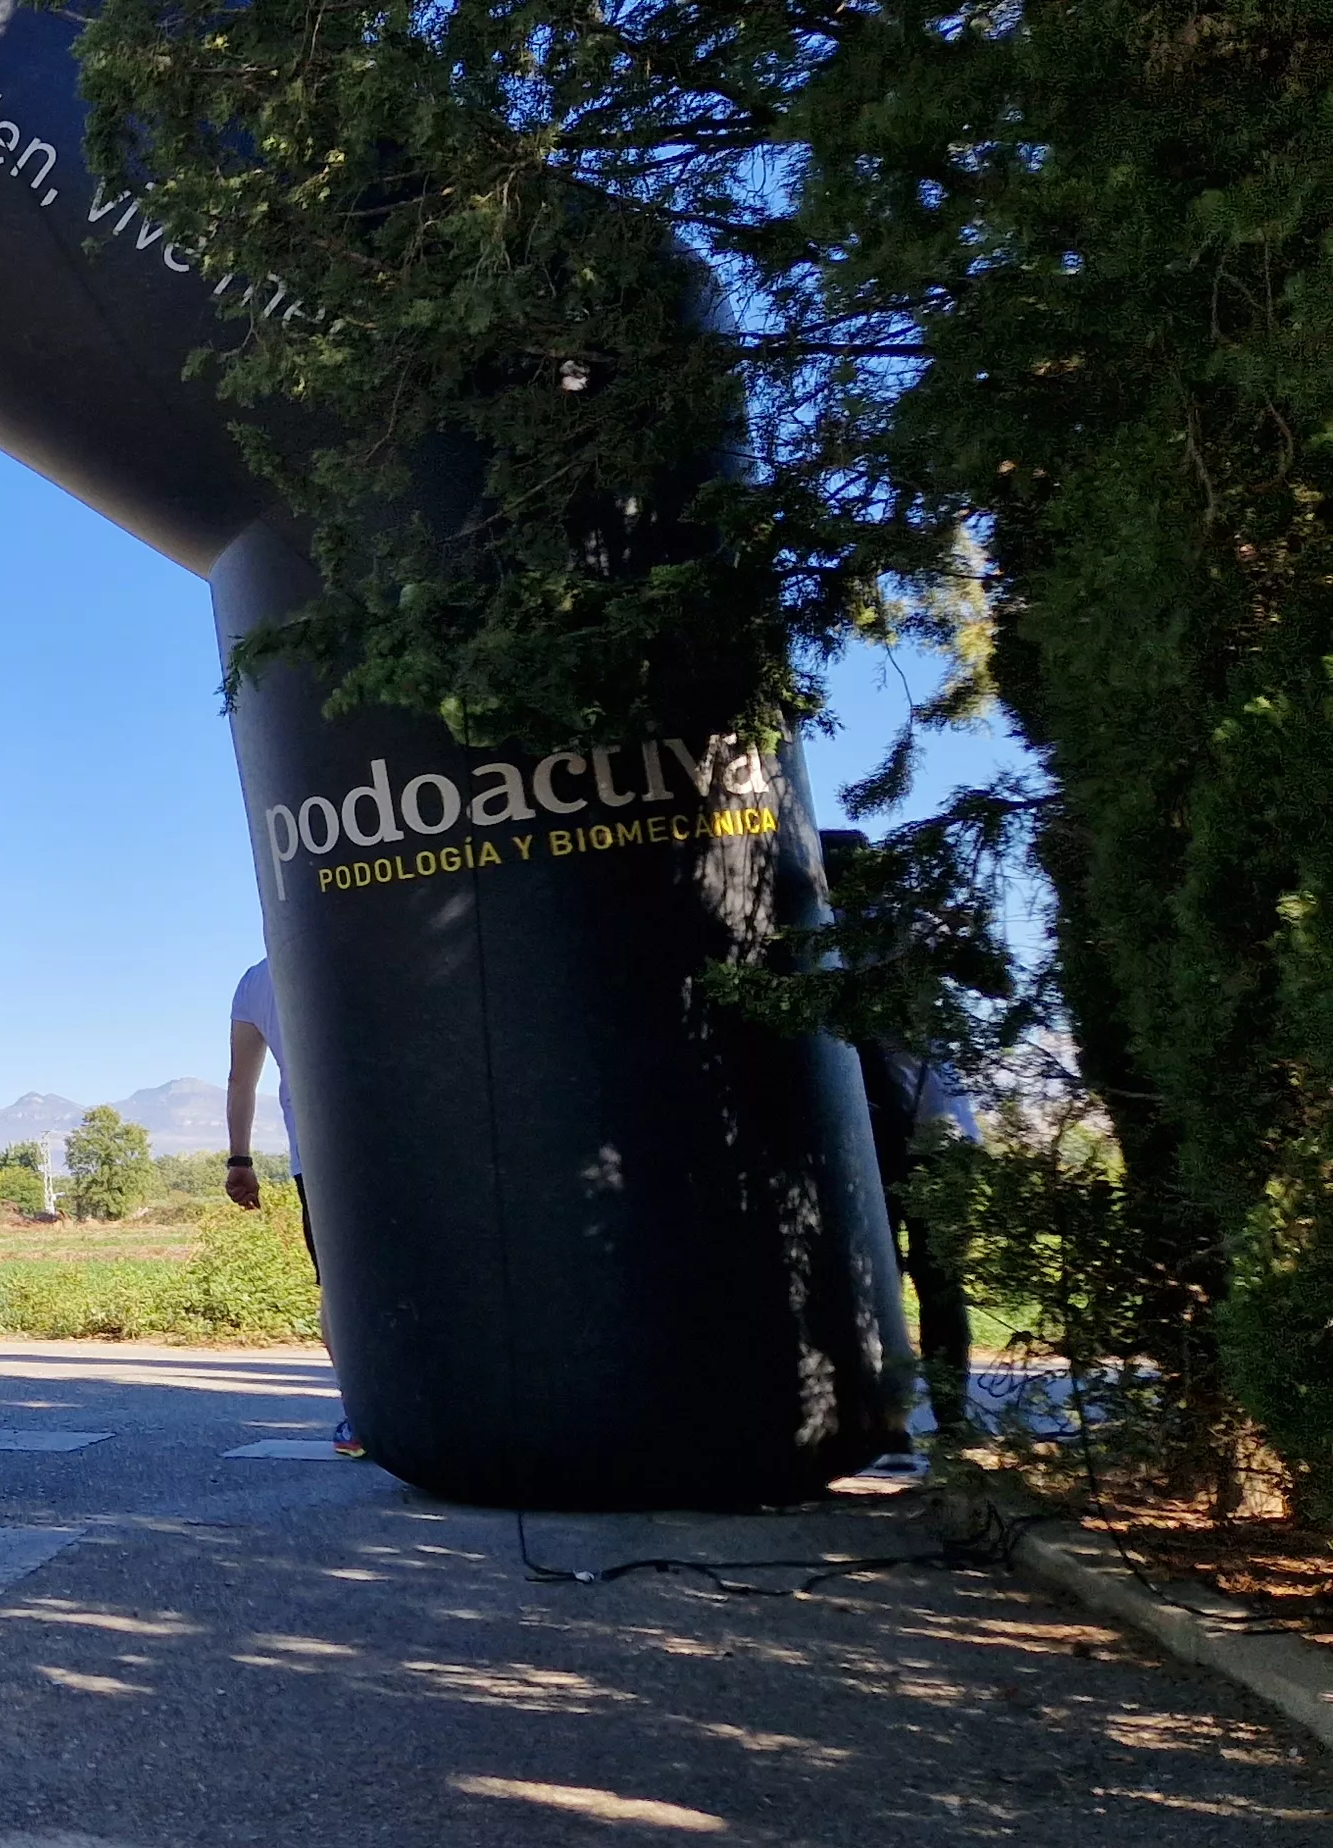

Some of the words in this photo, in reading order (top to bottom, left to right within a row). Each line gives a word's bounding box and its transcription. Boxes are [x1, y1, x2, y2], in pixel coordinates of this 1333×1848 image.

[265, 730, 770, 902] podoactiva
[319, 835, 503, 893] PODOLOGÍA
[511, 834, 535, 861] Y
[548, 804, 779, 857] BIOMECÁNICA
